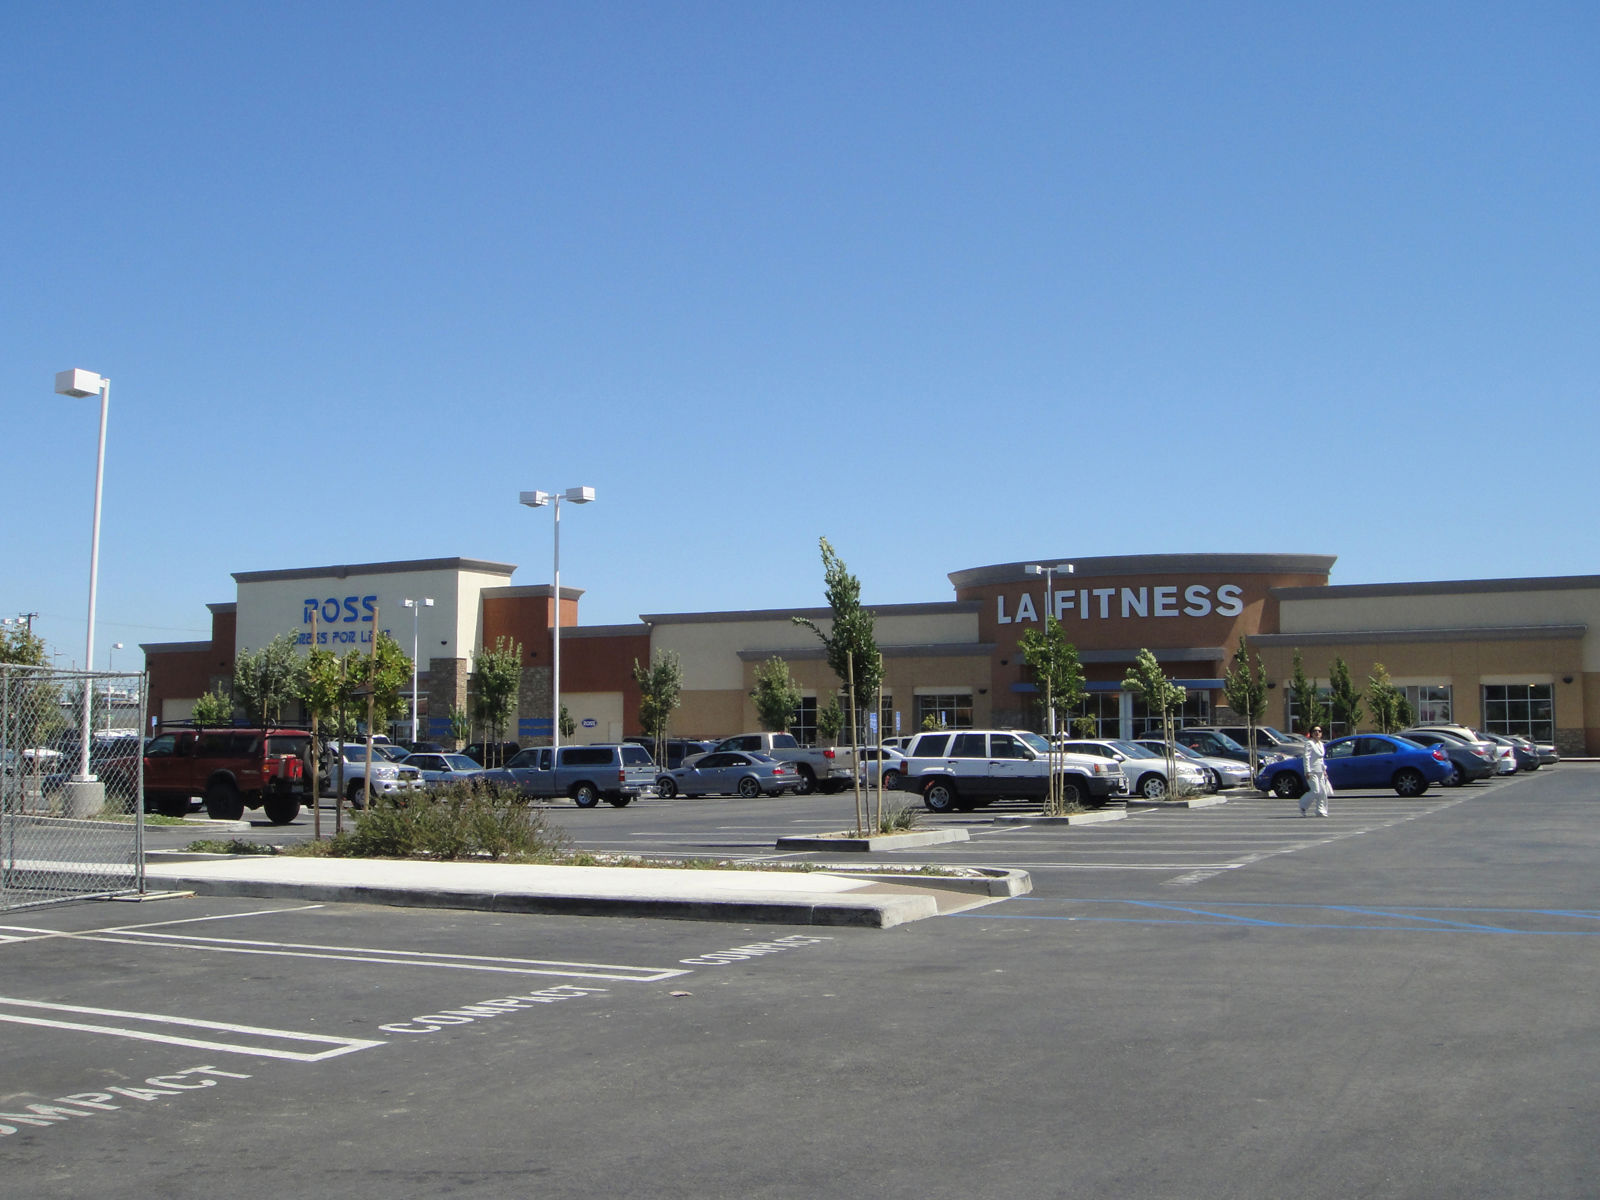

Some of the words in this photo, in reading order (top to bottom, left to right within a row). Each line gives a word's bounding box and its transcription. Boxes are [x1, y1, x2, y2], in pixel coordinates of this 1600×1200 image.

[304, 596, 377, 624] ROSS
[997, 593, 1038, 624] LA
[1055, 584, 1244, 621] FITNESS
[679, 935, 834, 965] COMPACT
[378, 984, 609, 1033] COMPACT
[0, 1065, 253, 1136] MPACT
